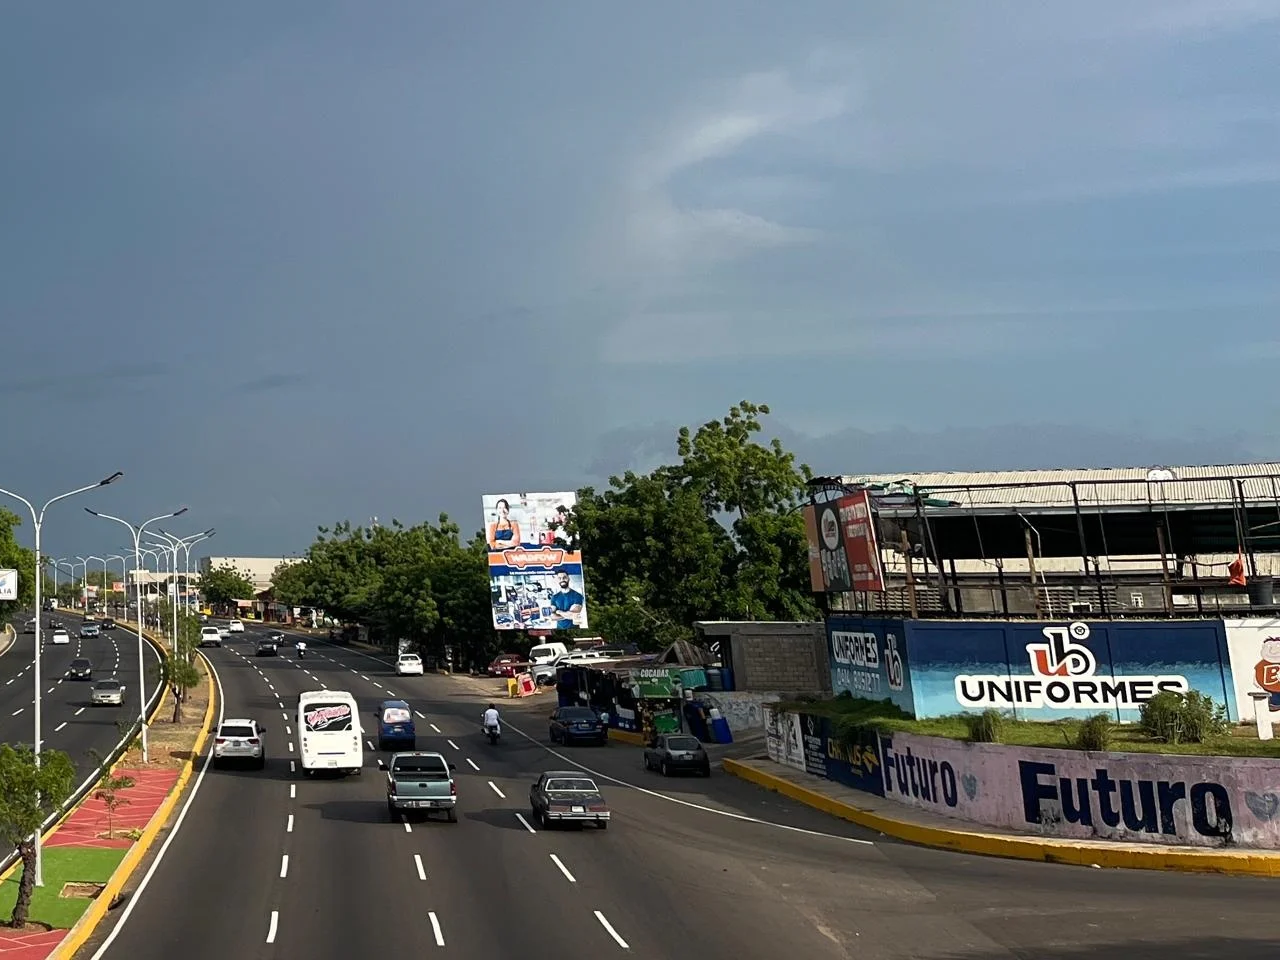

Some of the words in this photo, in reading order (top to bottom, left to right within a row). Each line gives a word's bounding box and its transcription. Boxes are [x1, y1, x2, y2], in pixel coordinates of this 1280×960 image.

[833, 634, 878, 664] UNIFORMES
[882, 739, 959, 808] Futuro
[1018, 759, 1234, 838] Futuro
